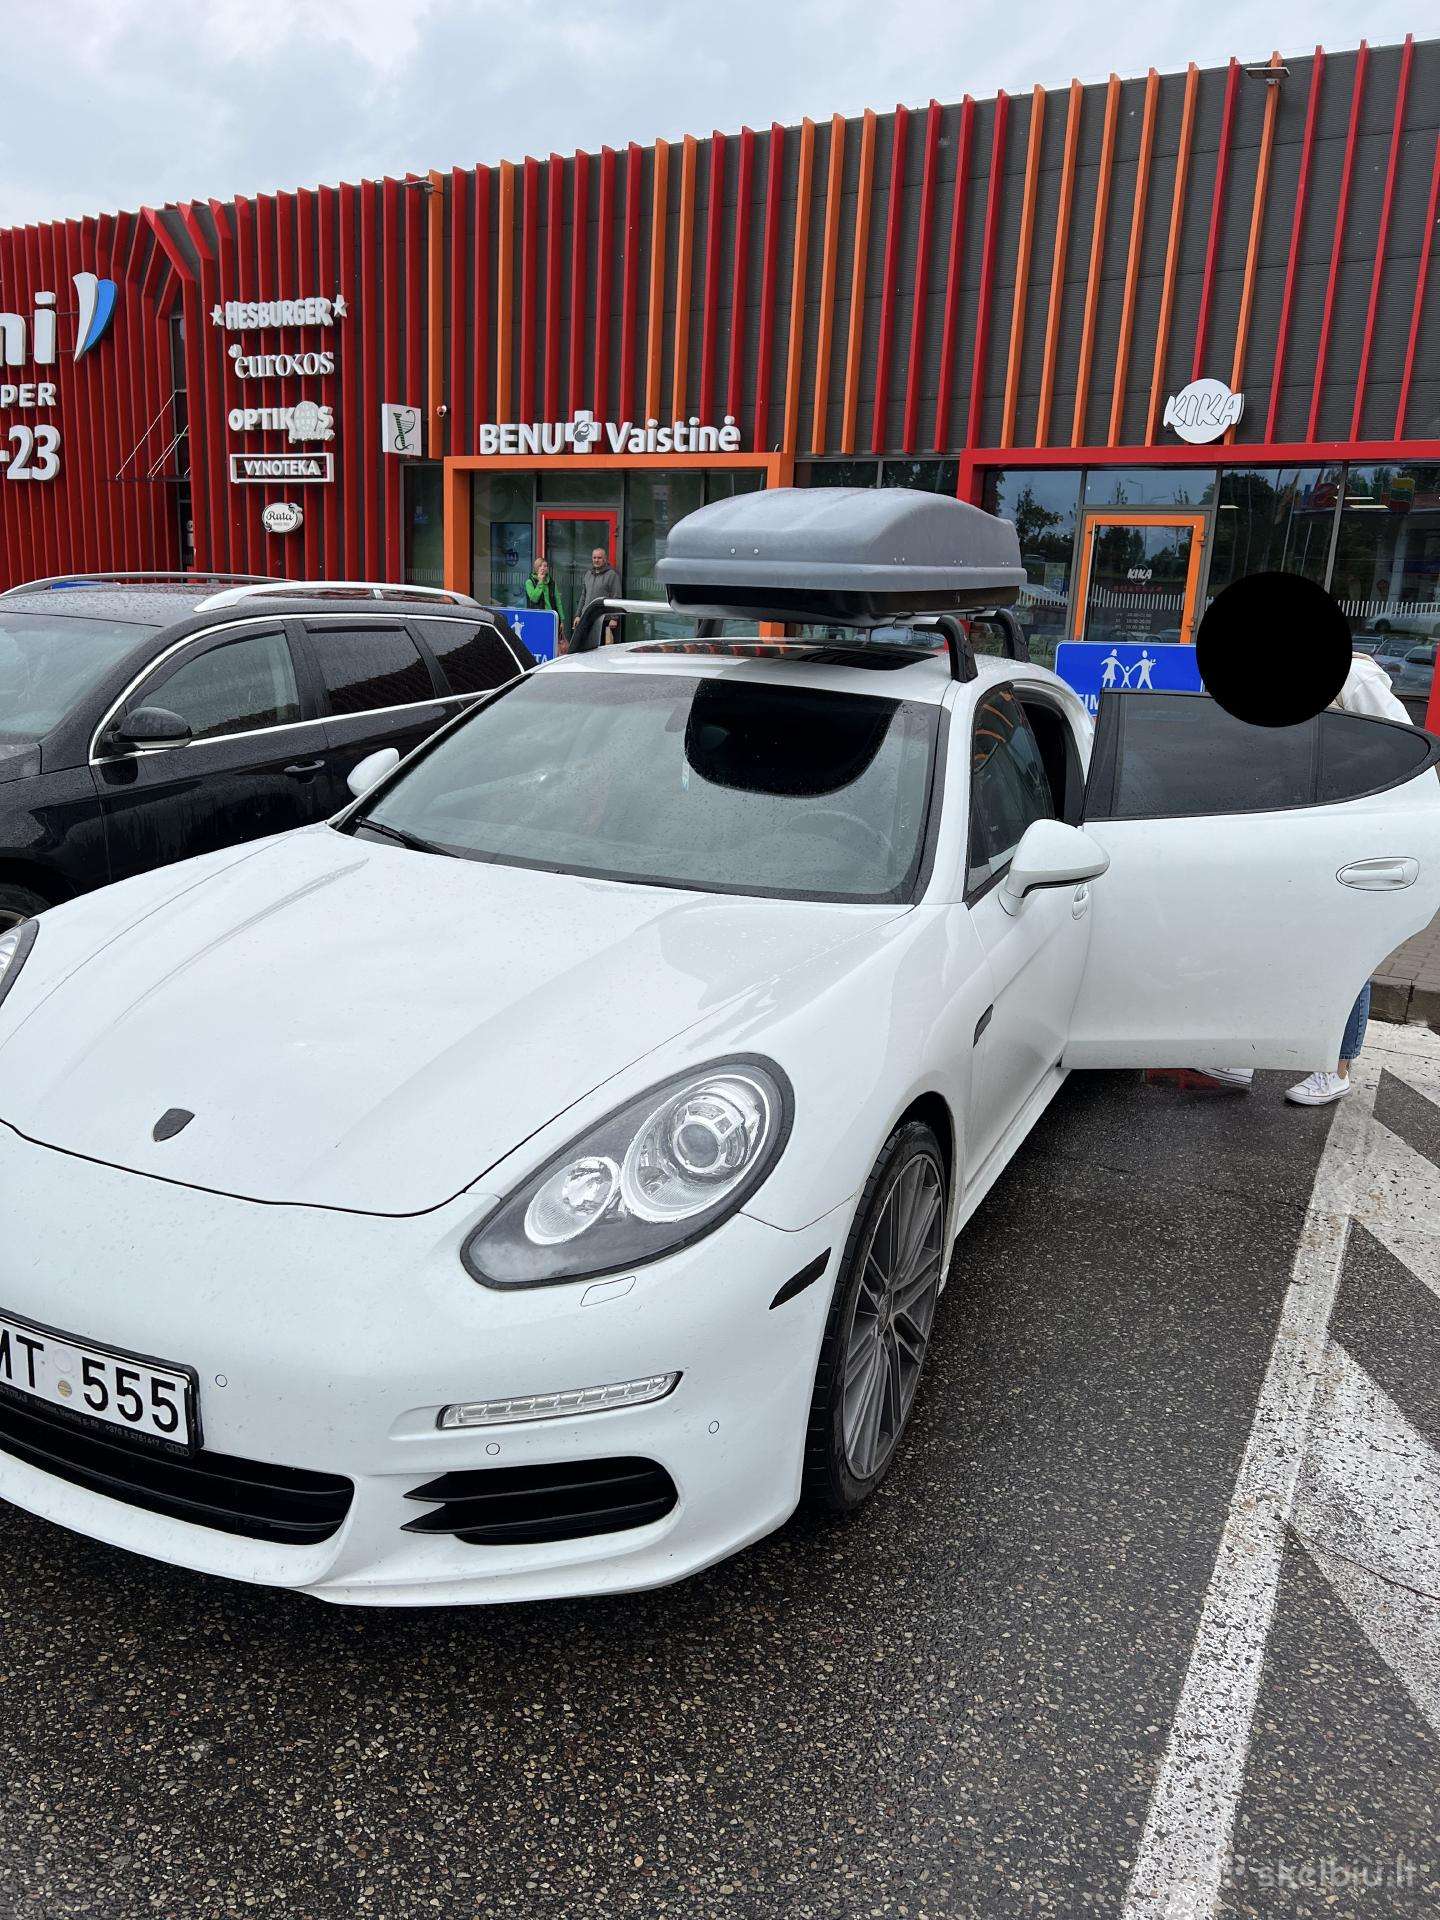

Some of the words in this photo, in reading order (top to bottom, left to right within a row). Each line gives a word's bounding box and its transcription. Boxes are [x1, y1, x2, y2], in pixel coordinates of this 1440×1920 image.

[225, 297, 334, 330] HESBURGER
[234, 351, 335, 379] eurokos
[1162, 392, 1244, 428] KIKA
[479, 422, 566, 455] BENU
[605, 415, 741, 454] Vaistinė
[243, 460, 322, 476] VYNOTEKA
[1126, 563, 1153, 580] KIKA
[81, 1356, 179, 1434] 555
